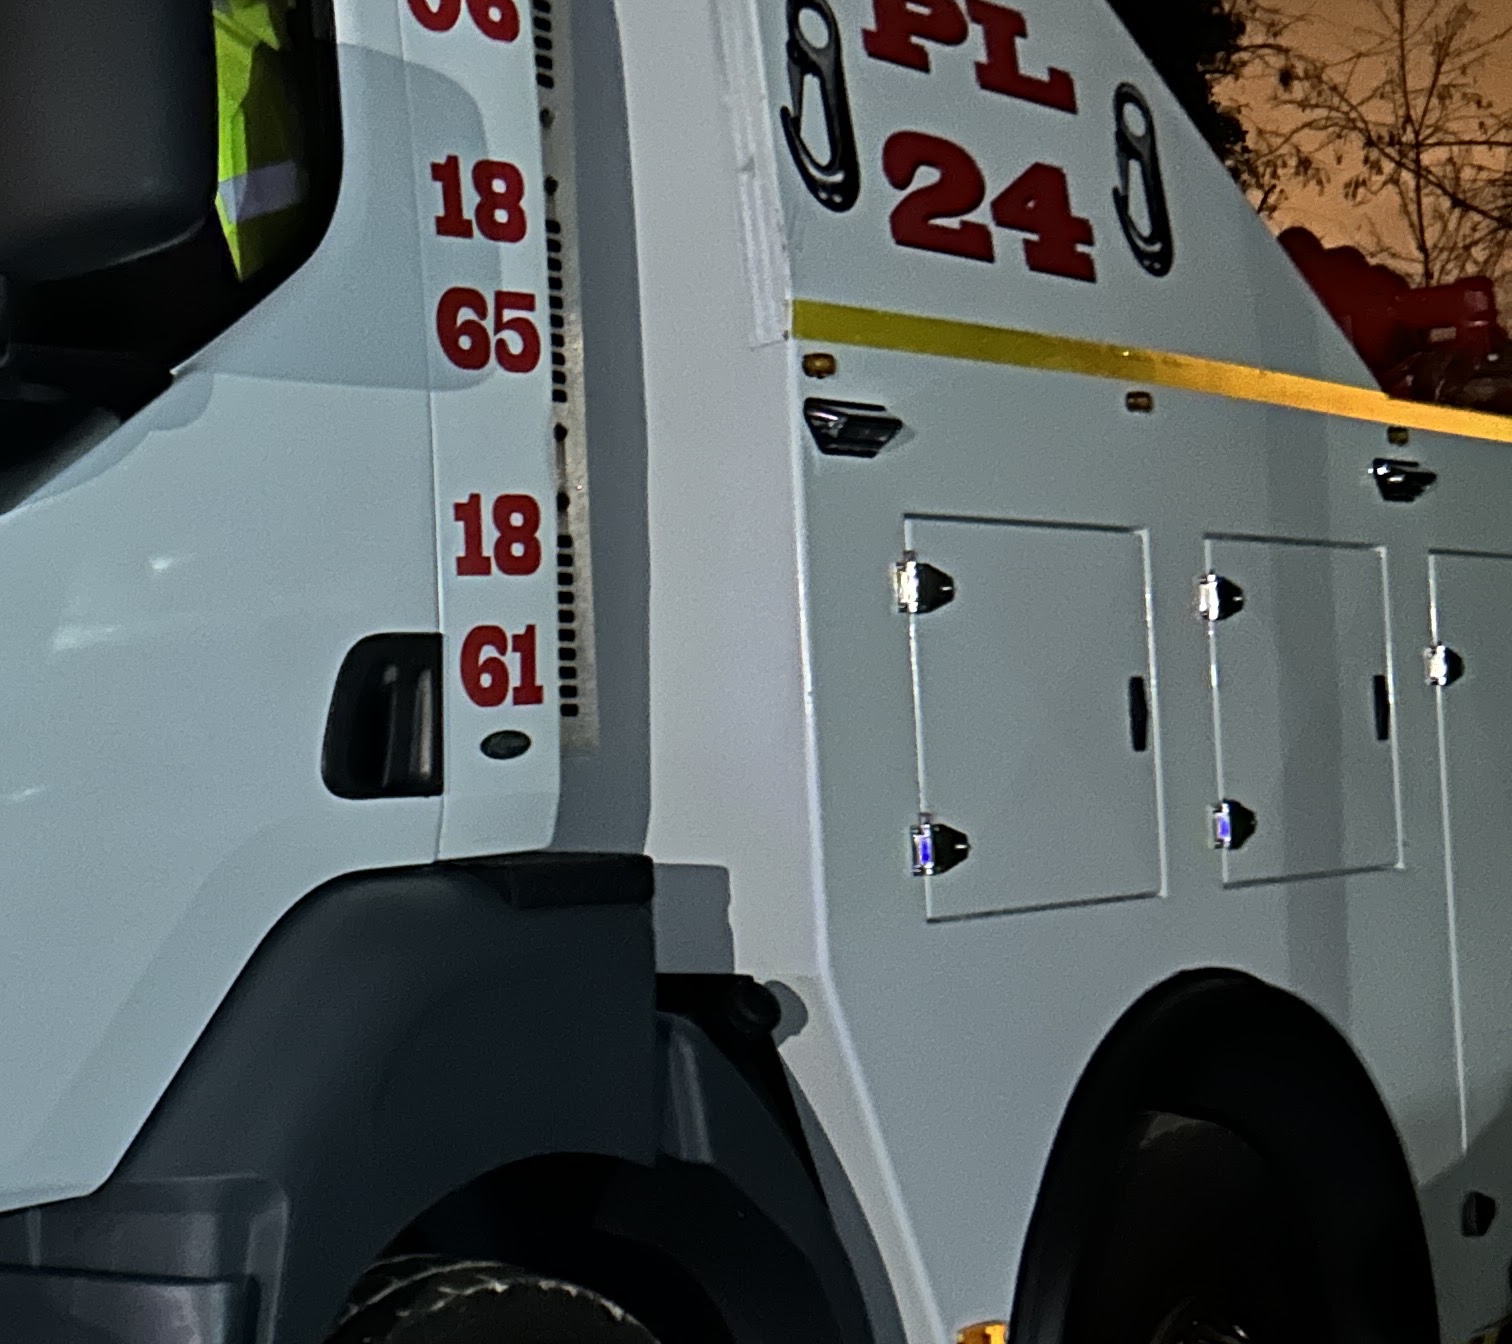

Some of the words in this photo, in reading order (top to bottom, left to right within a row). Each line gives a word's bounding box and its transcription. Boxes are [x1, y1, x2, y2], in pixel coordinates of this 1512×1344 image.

[430, 154, 528, 244] 18
[882, 130, 1096, 284] 24
[435, 286, 542, 373] 65
[453, 493, 542, 577] 18
[459, 624, 544, 708] 61
